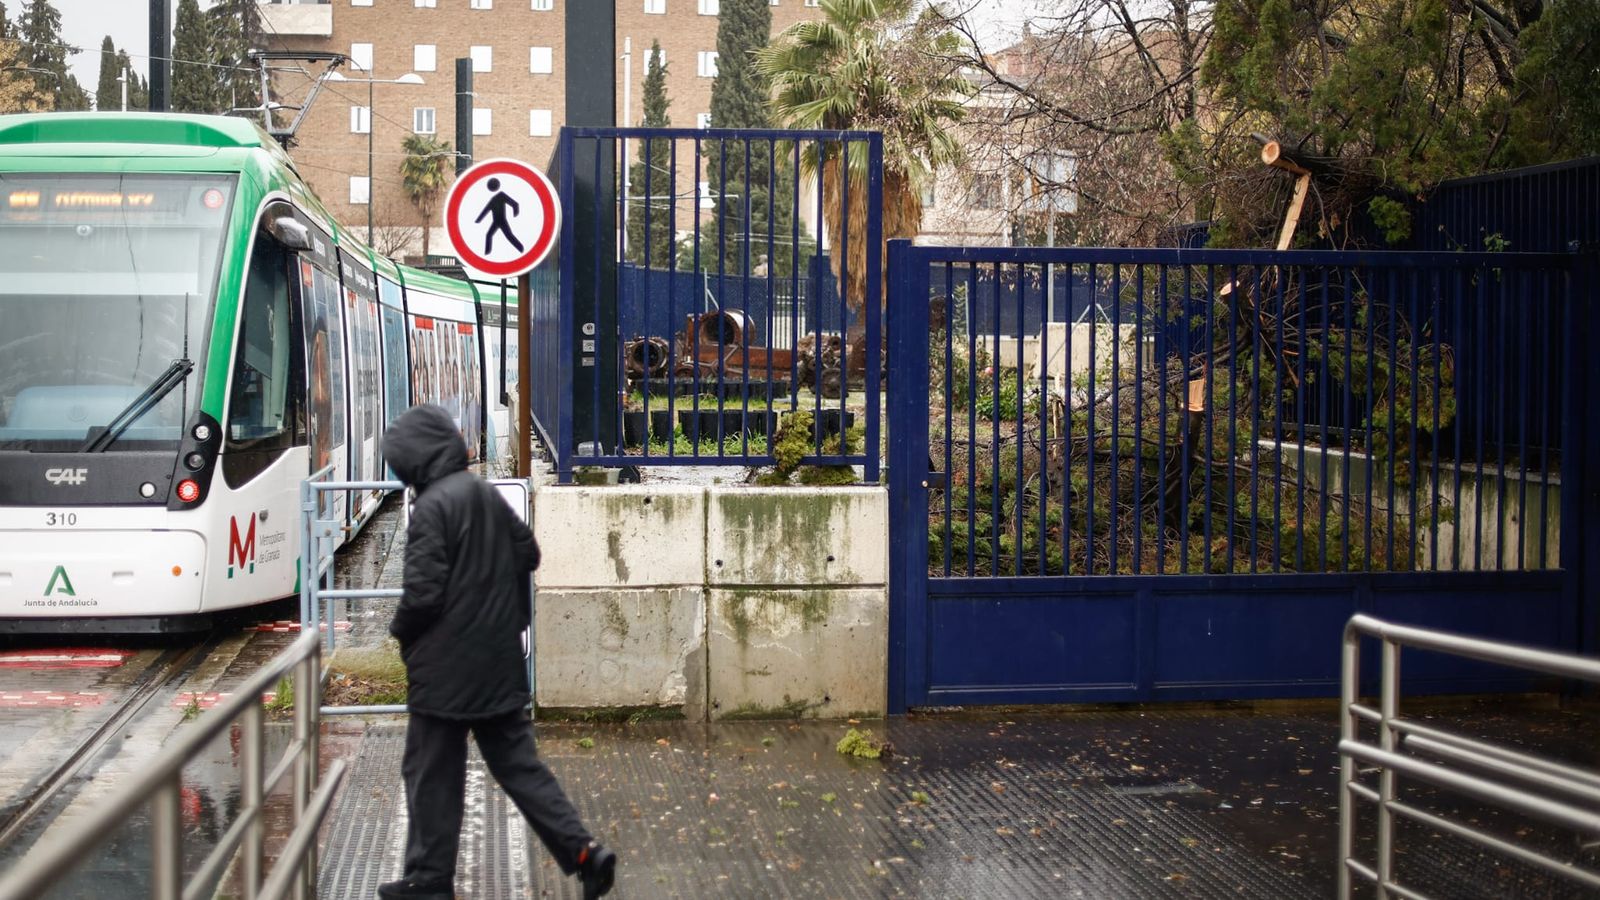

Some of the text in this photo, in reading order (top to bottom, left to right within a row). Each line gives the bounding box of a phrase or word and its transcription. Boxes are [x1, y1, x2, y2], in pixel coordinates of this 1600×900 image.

[45, 468, 88, 485] CAF
[46, 512, 77, 526] 310
[228, 512, 256, 579] M
[259, 531, 287, 547] Metropolitano
[265, 549, 281, 563] Granada
[47, 599, 57, 607] de
[58, 598, 98, 607] Andalucía
